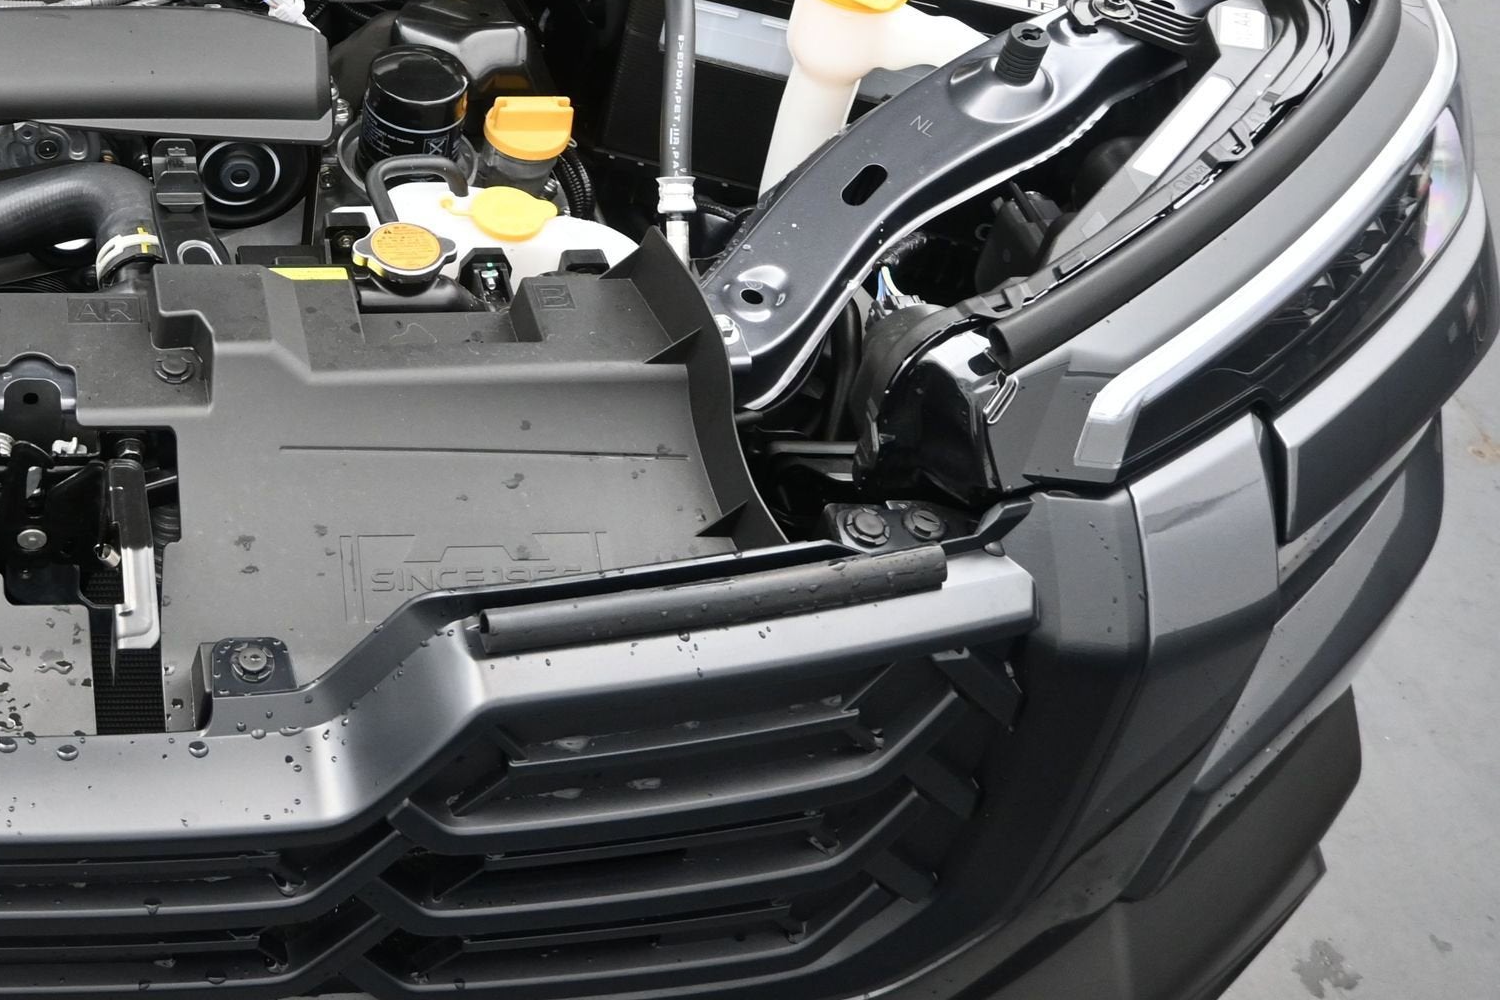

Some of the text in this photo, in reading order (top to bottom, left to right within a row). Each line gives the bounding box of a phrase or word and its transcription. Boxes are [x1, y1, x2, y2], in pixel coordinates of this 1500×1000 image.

[909, 114, 934, 138] NL
[74, 300, 135, 321] AR
[371, 567, 485, 592] SINCE
